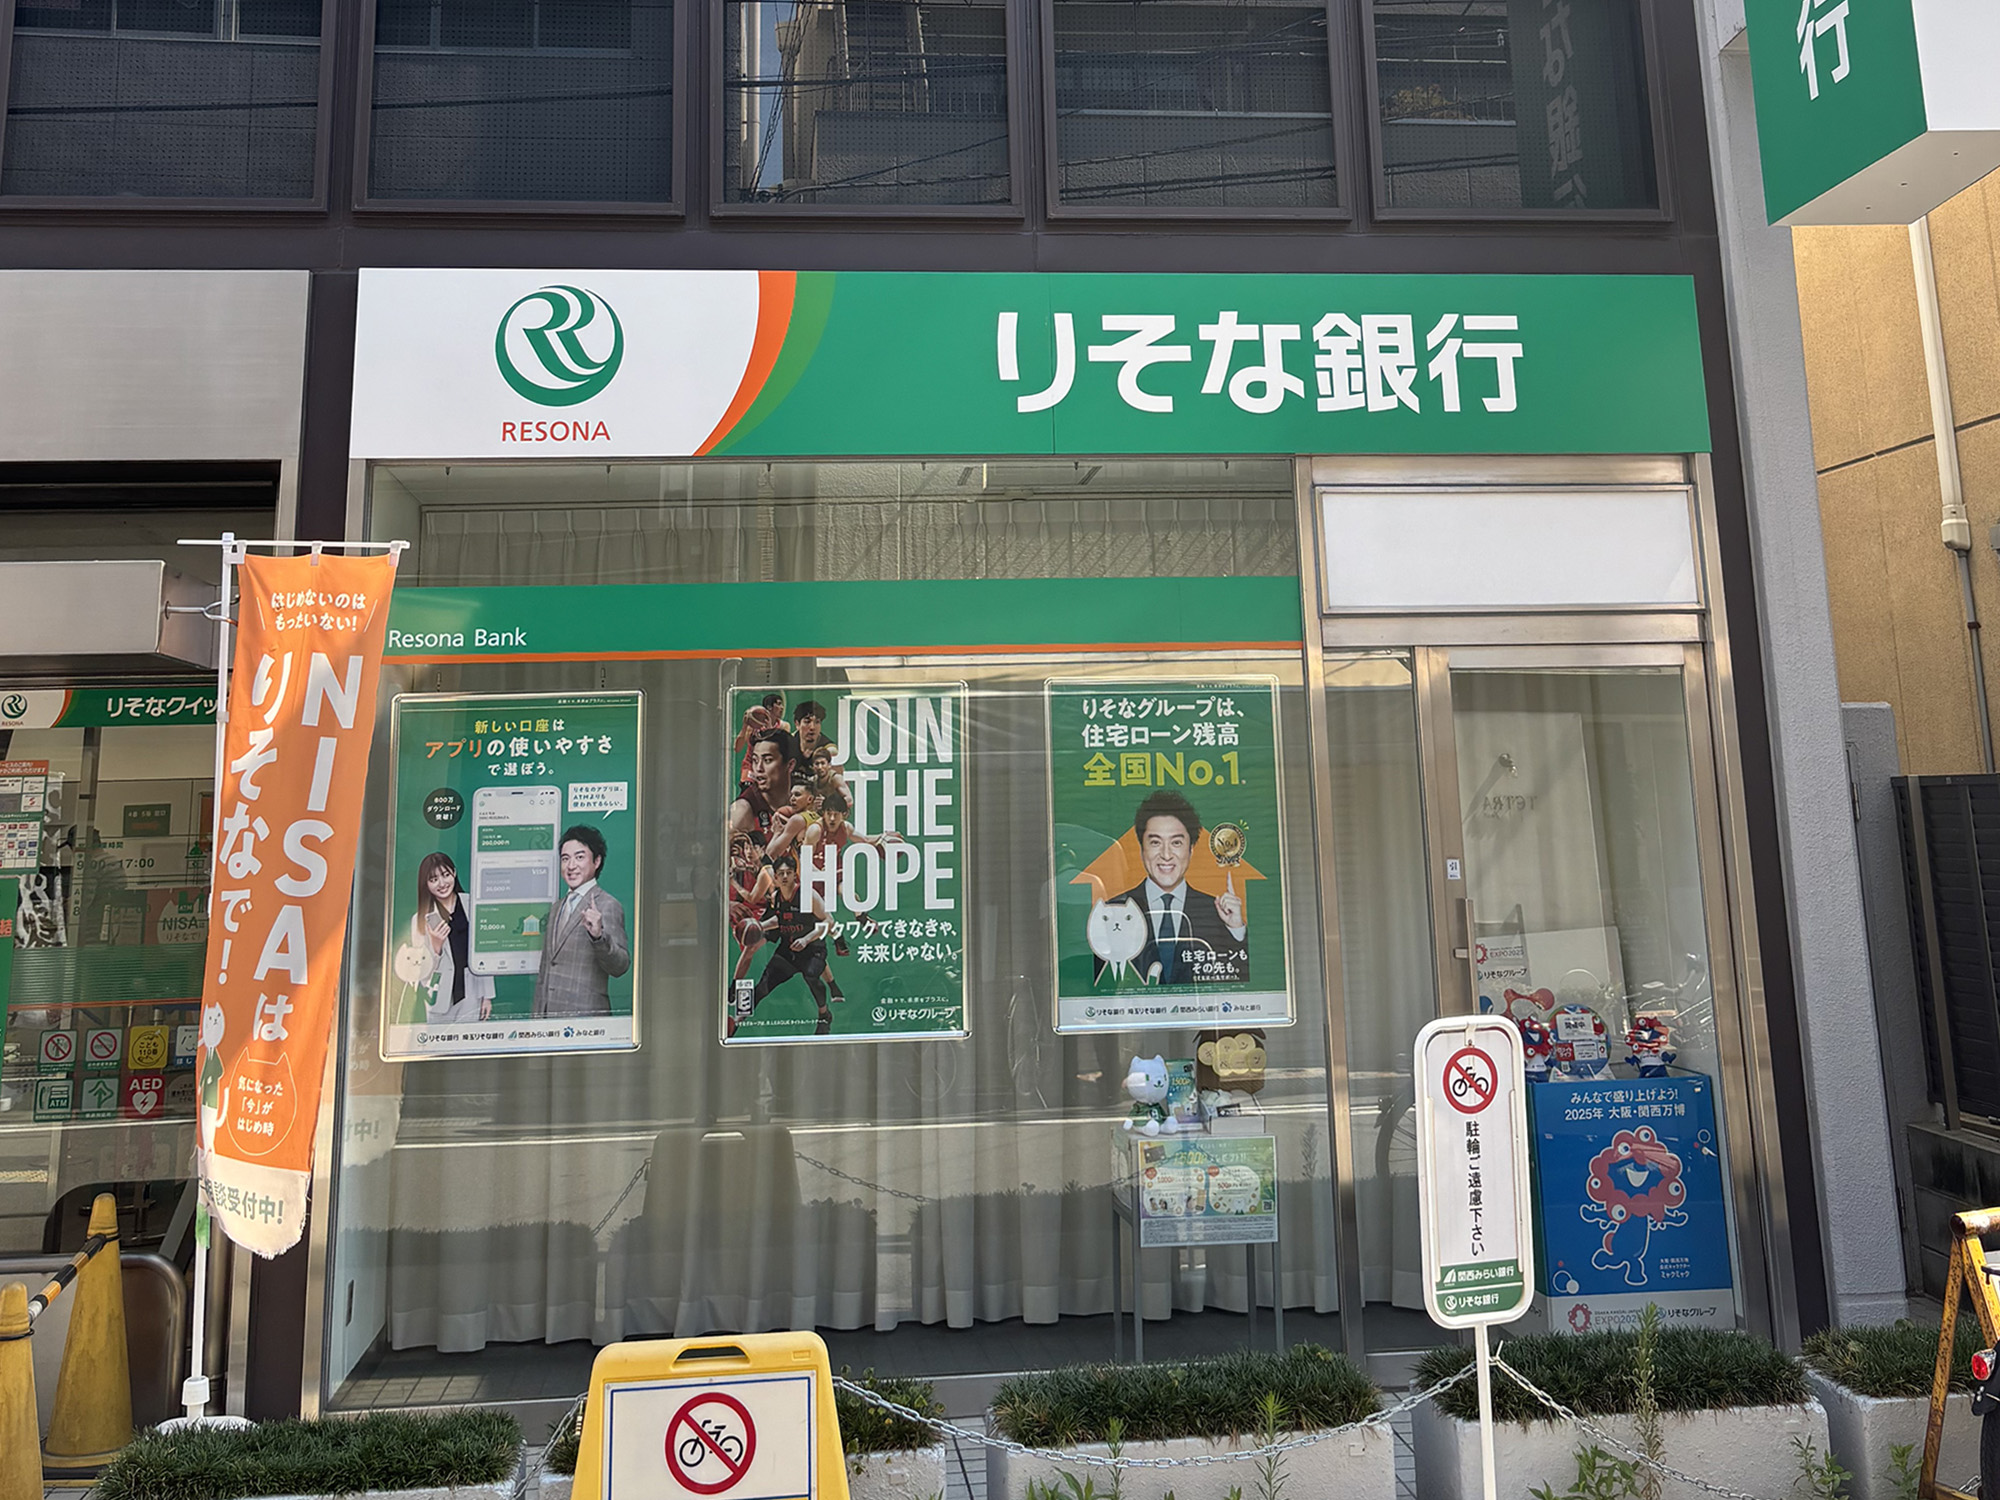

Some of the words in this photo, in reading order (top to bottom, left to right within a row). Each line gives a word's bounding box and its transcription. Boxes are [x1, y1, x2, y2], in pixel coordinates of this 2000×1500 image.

[1796, 0, 1851, 101] 行
[996, 311, 1526, 415] りそな銀行
[501, 421, 612, 442] RESONA
[270, 589, 367, 611] はじめないのは
[388, 629, 464, 648] Resona
[474, 627, 527, 647] Bank
[1081, 696, 1245, 720] りそなグループは、
[474, 718, 565, 734] 新しい口座は
[831, 697, 954, 767] JOIN
[1081, 722, 1240, 748] 住宅ローン残高
[425, 735, 613, 759] アプリの使いやすさ
[488, 762, 554, 776] で選ぼう。
[843, 769, 954, 839] THE
[217, 651, 293, 985] りそなで!
[252, 652, 364, 1042] NISAは
[800, 841, 955, 914] HOPE
[857, 941, 958, 963] 未来じゃない。
[1181, 949, 1248, 963] 住宅ローンも
[1192, 962, 1241, 974] その先も。
[1484, 968, 1527, 979] りそなグループ
[888, 1006, 957, 1020] りそなグループ
[129, 1078, 163, 1091] AED
[238, 1075, 284, 1096] 気になった
[50, 1099, 68, 1107] ATM
[241, 1096, 275, 1115] 「今」が
[1570, 1088, 1679, 1104] みんなで盛り上げよう!
[1564, 1108, 1604, 1121] 2025年
[1608, 1103, 1686, 1120] 大阪・関西万博
[237, 1117, 275, 1137] はじめ時
[1465, 1120, 1485, 1256] 駐輪ご遠慮下さい
[1457, 1265, 1514, 1282] 関西みらい銀行
[1458, 1293, 1499, 1308] りそな銀行
[1595, 1314, 1637, 1325] EXPO202
[1668, 1307, 1717, 1318] りそなグループ
